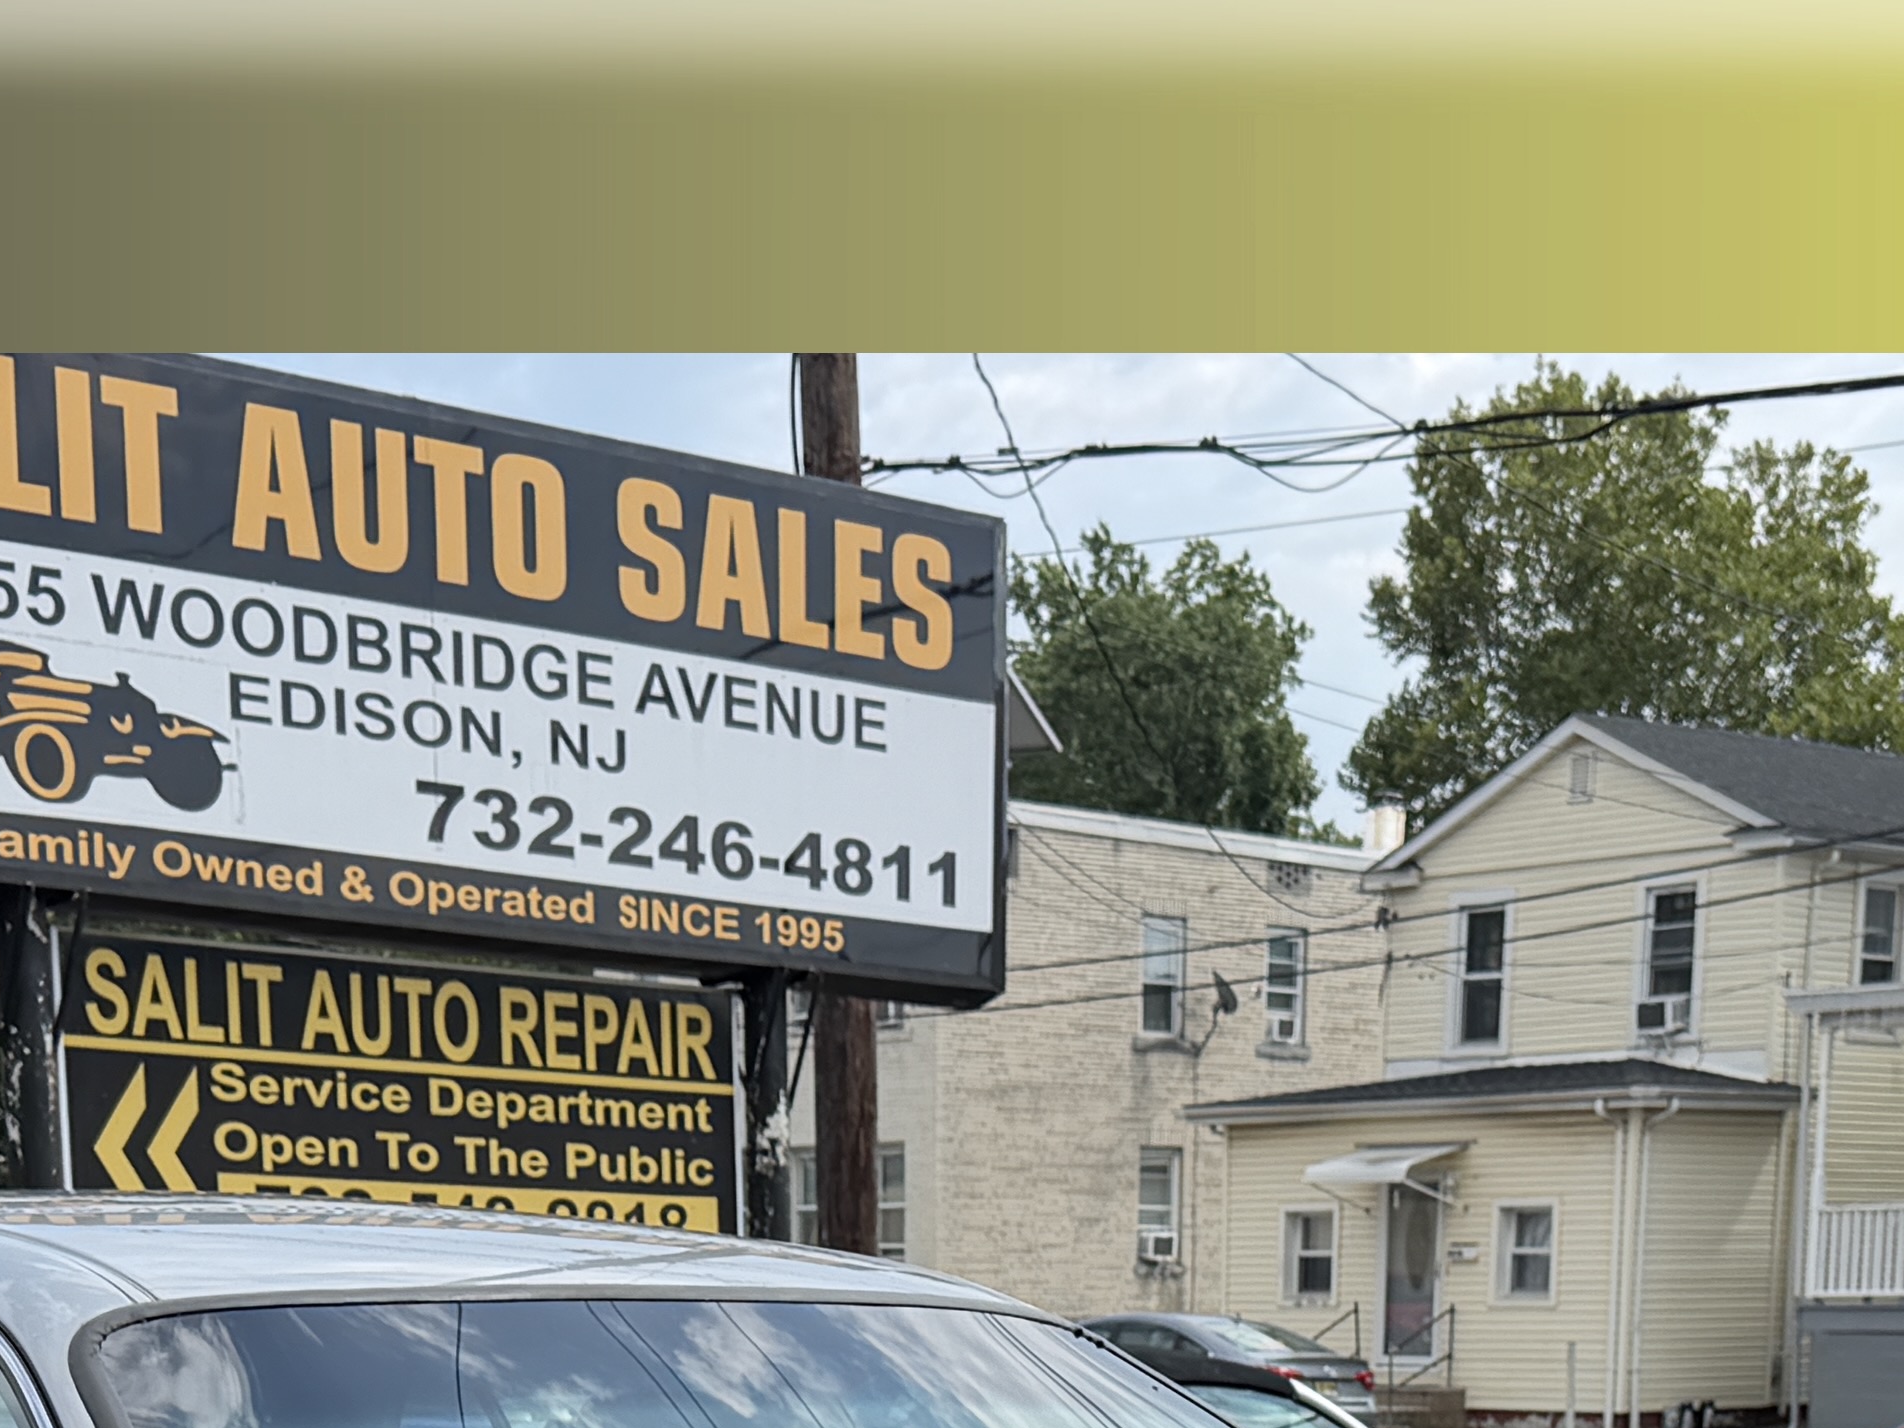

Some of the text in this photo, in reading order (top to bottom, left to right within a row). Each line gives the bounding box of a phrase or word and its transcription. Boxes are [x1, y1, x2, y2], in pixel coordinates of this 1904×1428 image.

[232, 402, 567, 601] AUTO
[617, 477, 953, 670] SALES
[91, 573, 615, 709] WOODBRIDGE
[635, 663, 888, 752] AVENUE
[229, 672, 627, 773] EDISON, NJ
[153, 840, 324, 896] Owned
[339, 866, 375, 902] &
[389, 870, 595, 924] Operated
[619, 895, 739, 941] SINCE
[754, 911, 845, 953] 1995
[415, 779, 957, 908] 732-246-4811
[85, 948, 717, 1080] SALIT AUTO REPAIR
[210, 1062, 714, 1133] Service Department
[213, 1121, 714, 1187] Open To The Public
